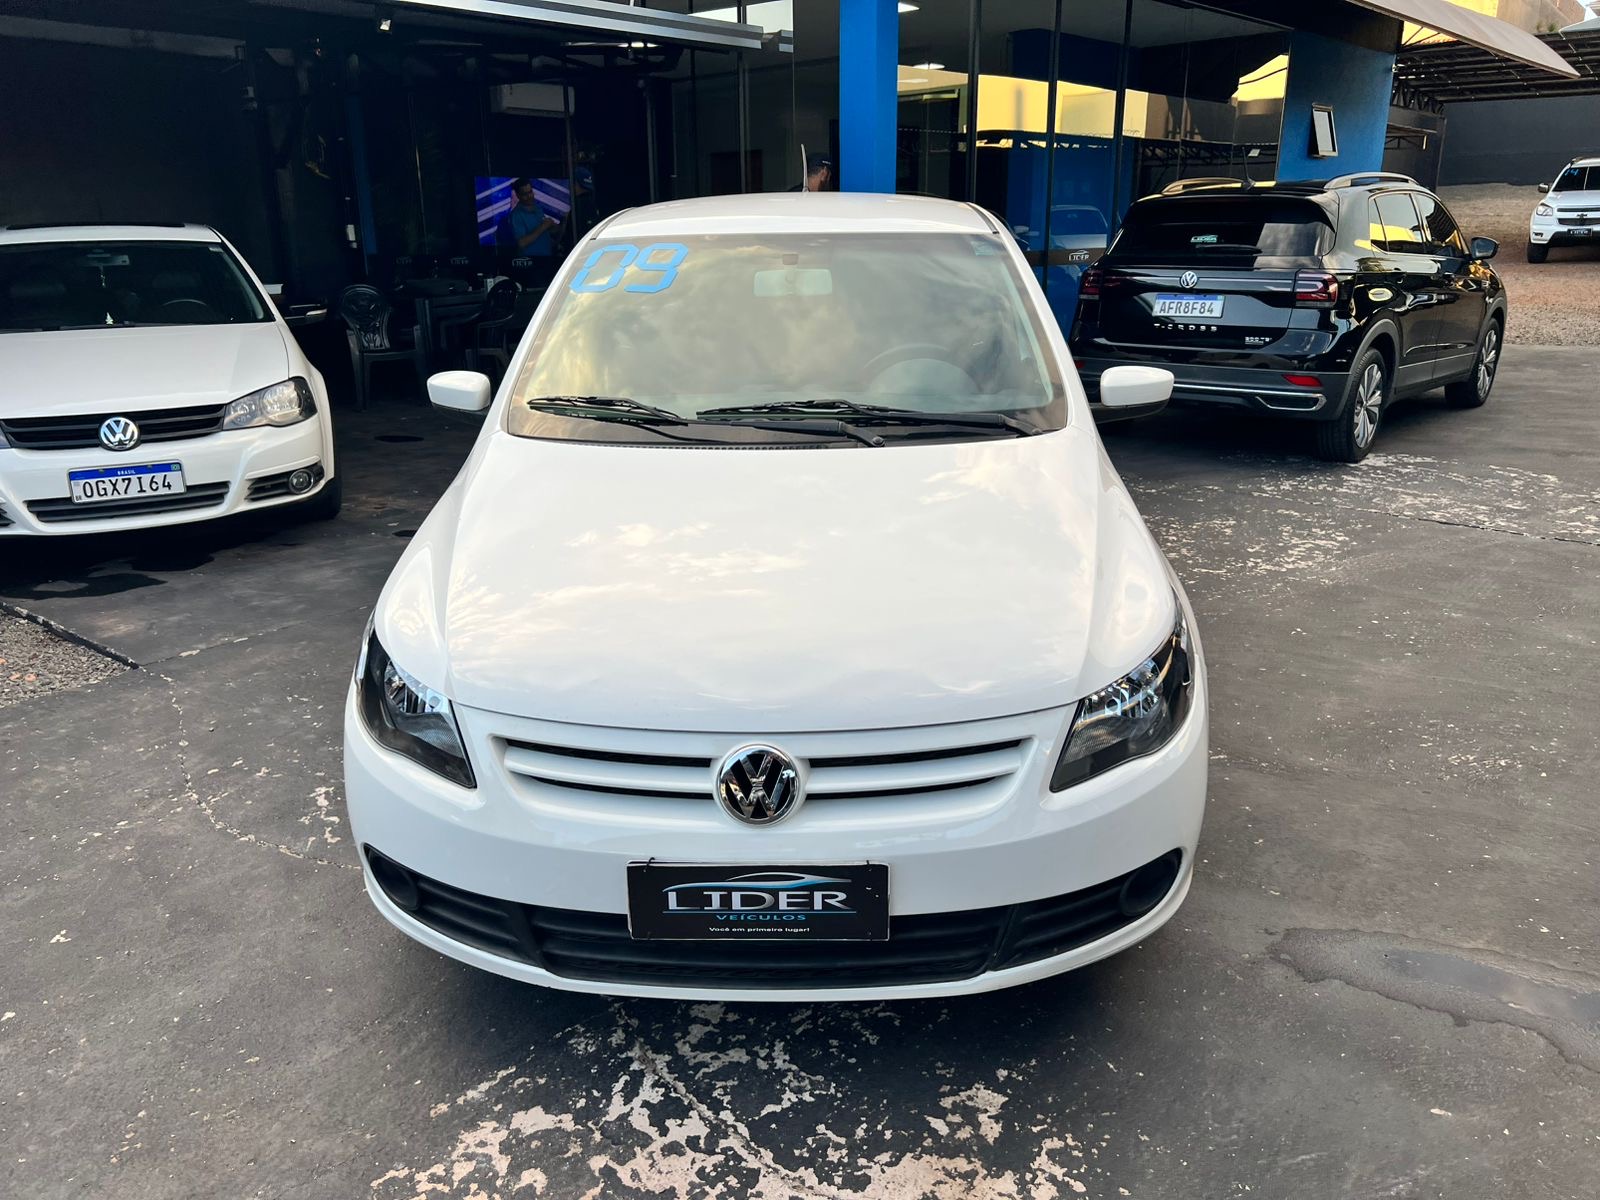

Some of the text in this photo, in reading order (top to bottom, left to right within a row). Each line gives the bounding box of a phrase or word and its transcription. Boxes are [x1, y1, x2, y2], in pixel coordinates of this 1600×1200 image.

[568, 242, 689, 294] 09
[1159, 301, 1214, 316] AFR8F84
[82, 474, 172, 499] OGX7I64
[667, 890, 851, 911] LIDER
[715, 913, 807, 921] VEÍCULOS
